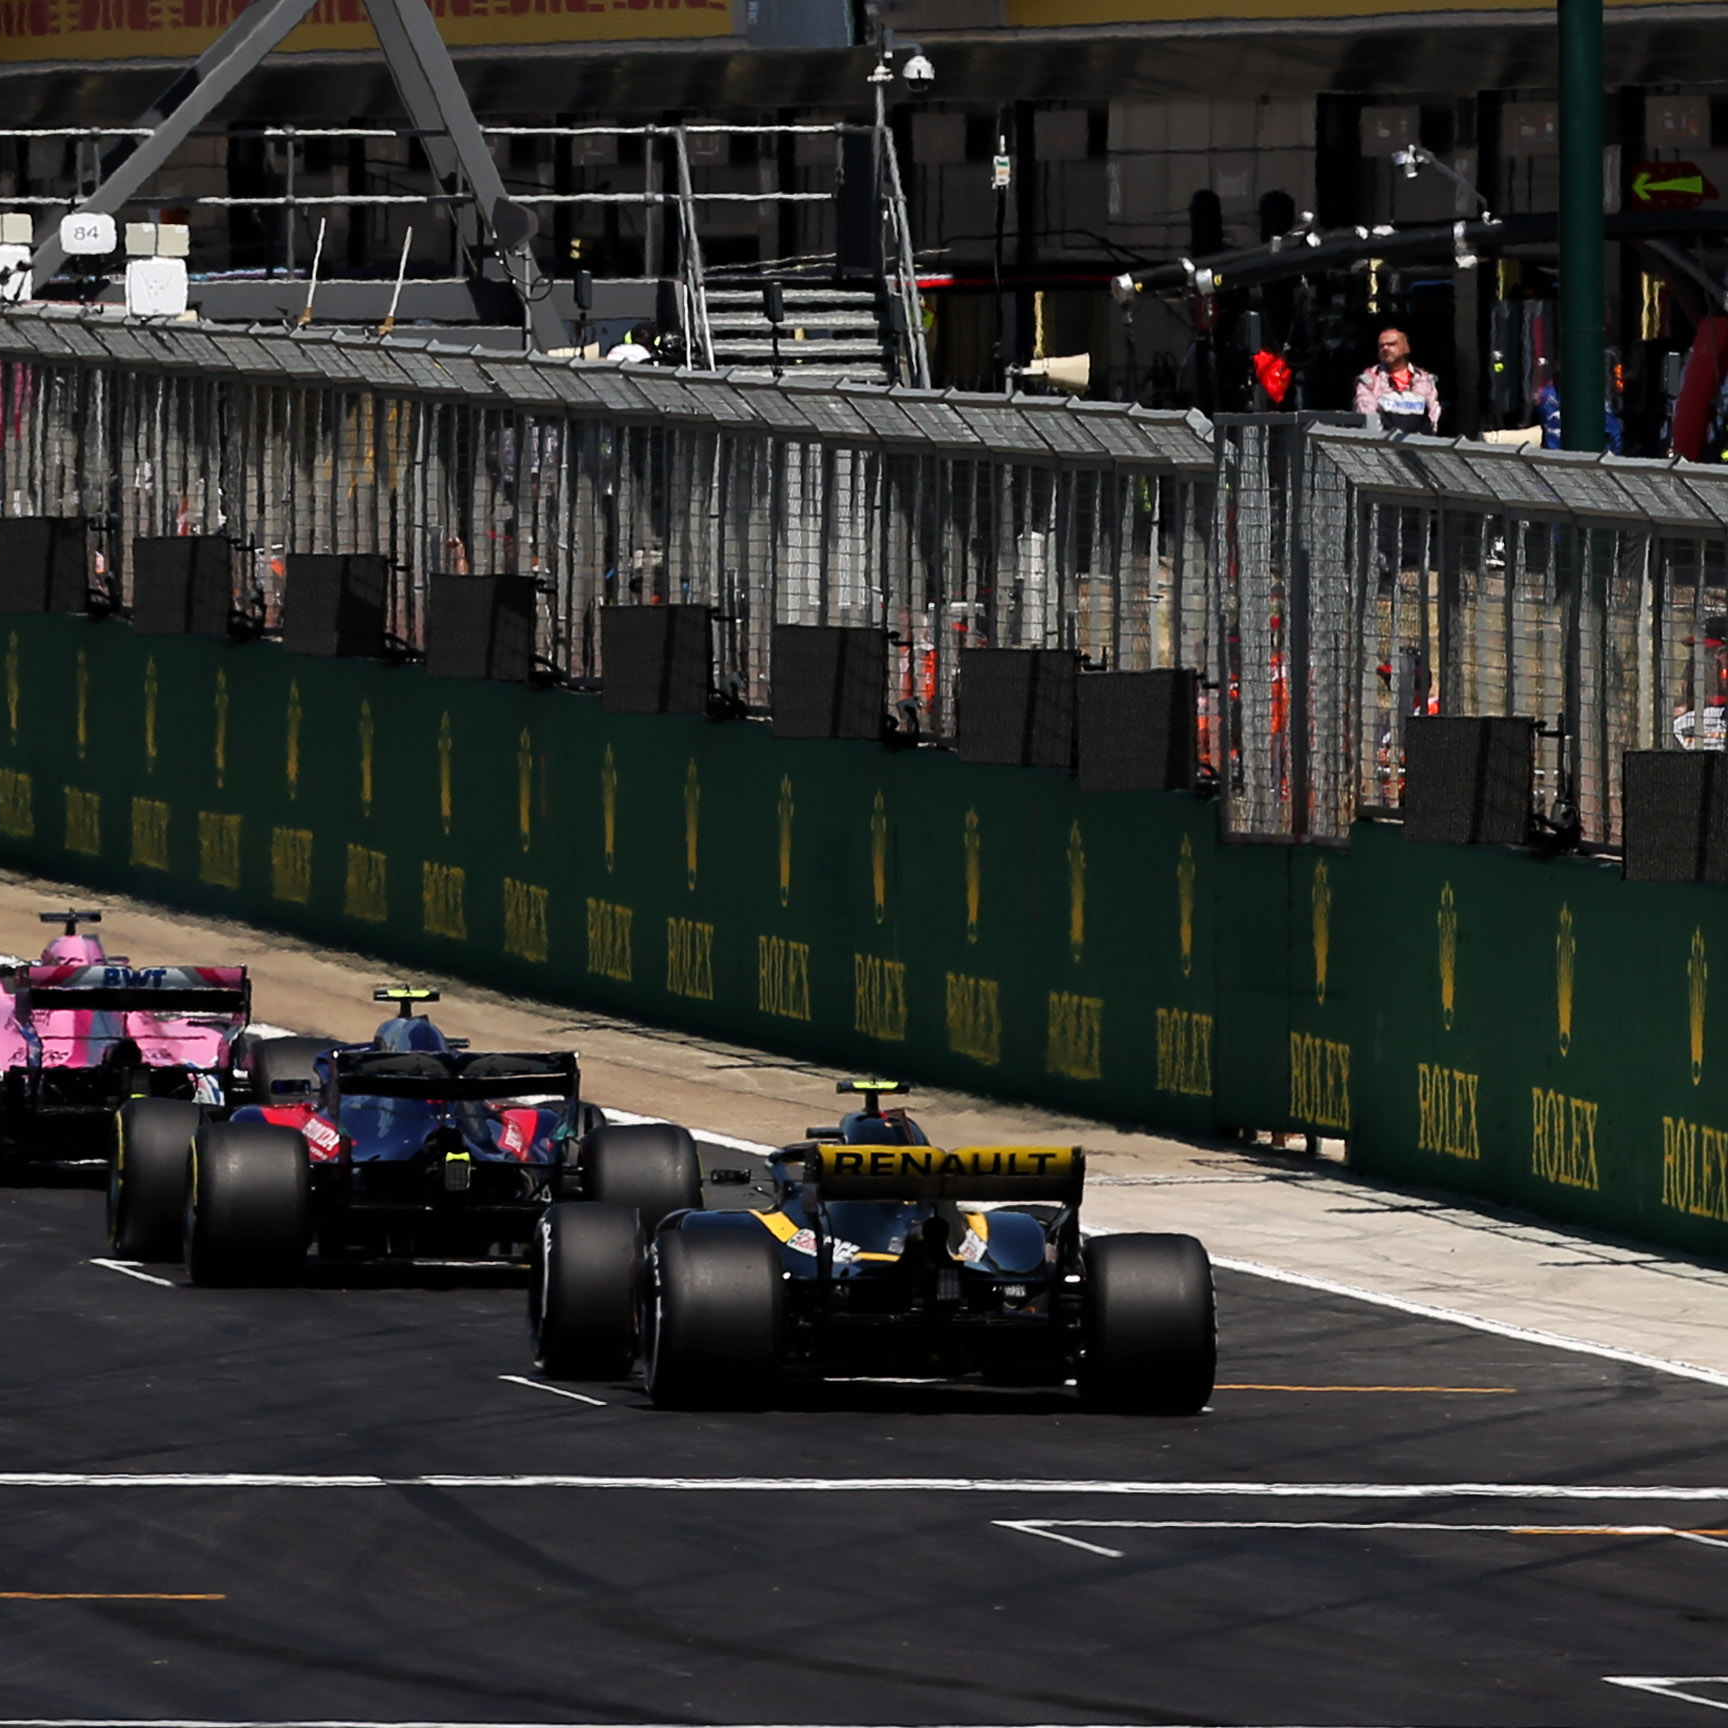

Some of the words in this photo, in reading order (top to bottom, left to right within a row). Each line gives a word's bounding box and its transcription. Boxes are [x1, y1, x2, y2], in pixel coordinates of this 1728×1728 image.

[73, 225, 100, 241] 84
[102, 967, 167, 988] BWT
[759, 935, 811, 1021] ROLEX
[1289, 1031, 1350, 1130] ROLEX
[1417, 1062, 1480, 1160] ROLEX
[834, 1151, 1056, 1176] RENAULT
[1531, 1086, 1599, 1191] ROLEX
[1661, 1115, 1728, 1223] ROLEX
